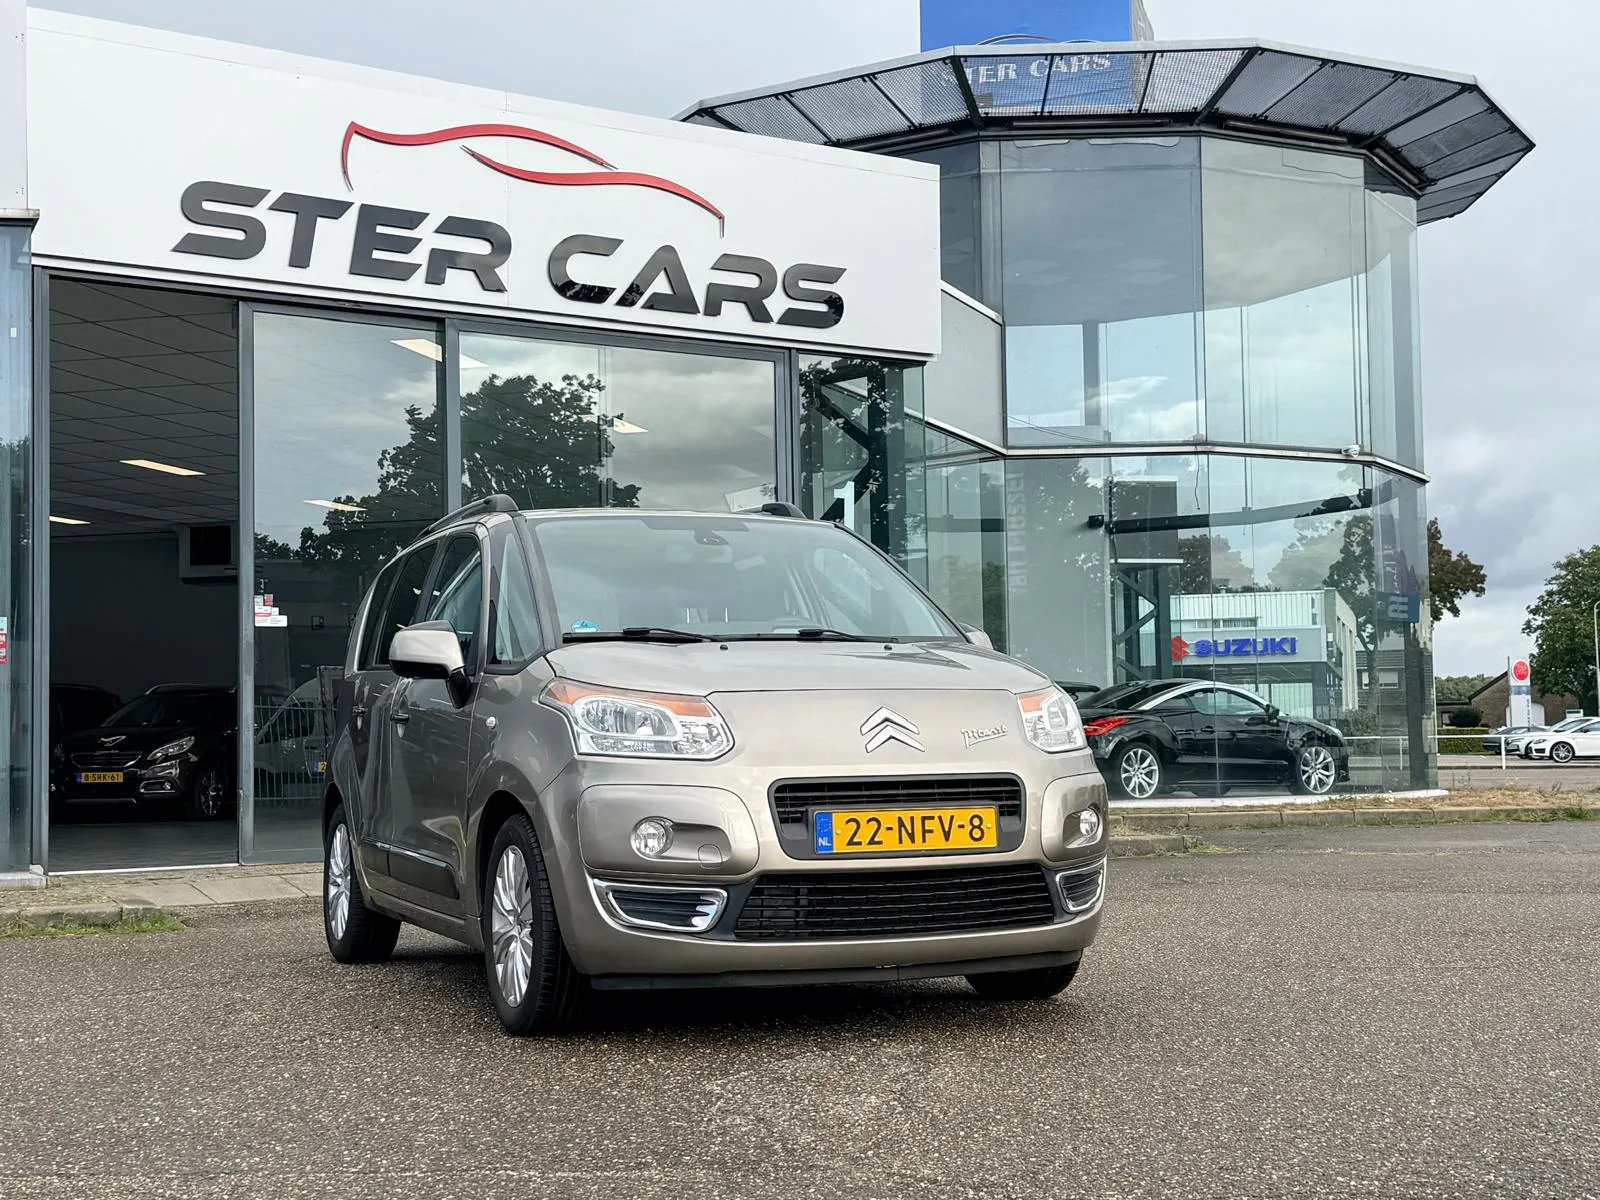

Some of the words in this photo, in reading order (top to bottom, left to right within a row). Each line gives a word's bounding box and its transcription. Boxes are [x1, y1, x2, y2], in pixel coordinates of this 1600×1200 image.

[1029, 53, 1112, 77] CARS
[171, 180, 513, 293] STER
[548, 233, 848, 330] CARS
[1194, 637, 1298, 657] SUZUKI
[818, 837, 832, 847] NL
[845, 813, 985, 847] 22-NFV-8
